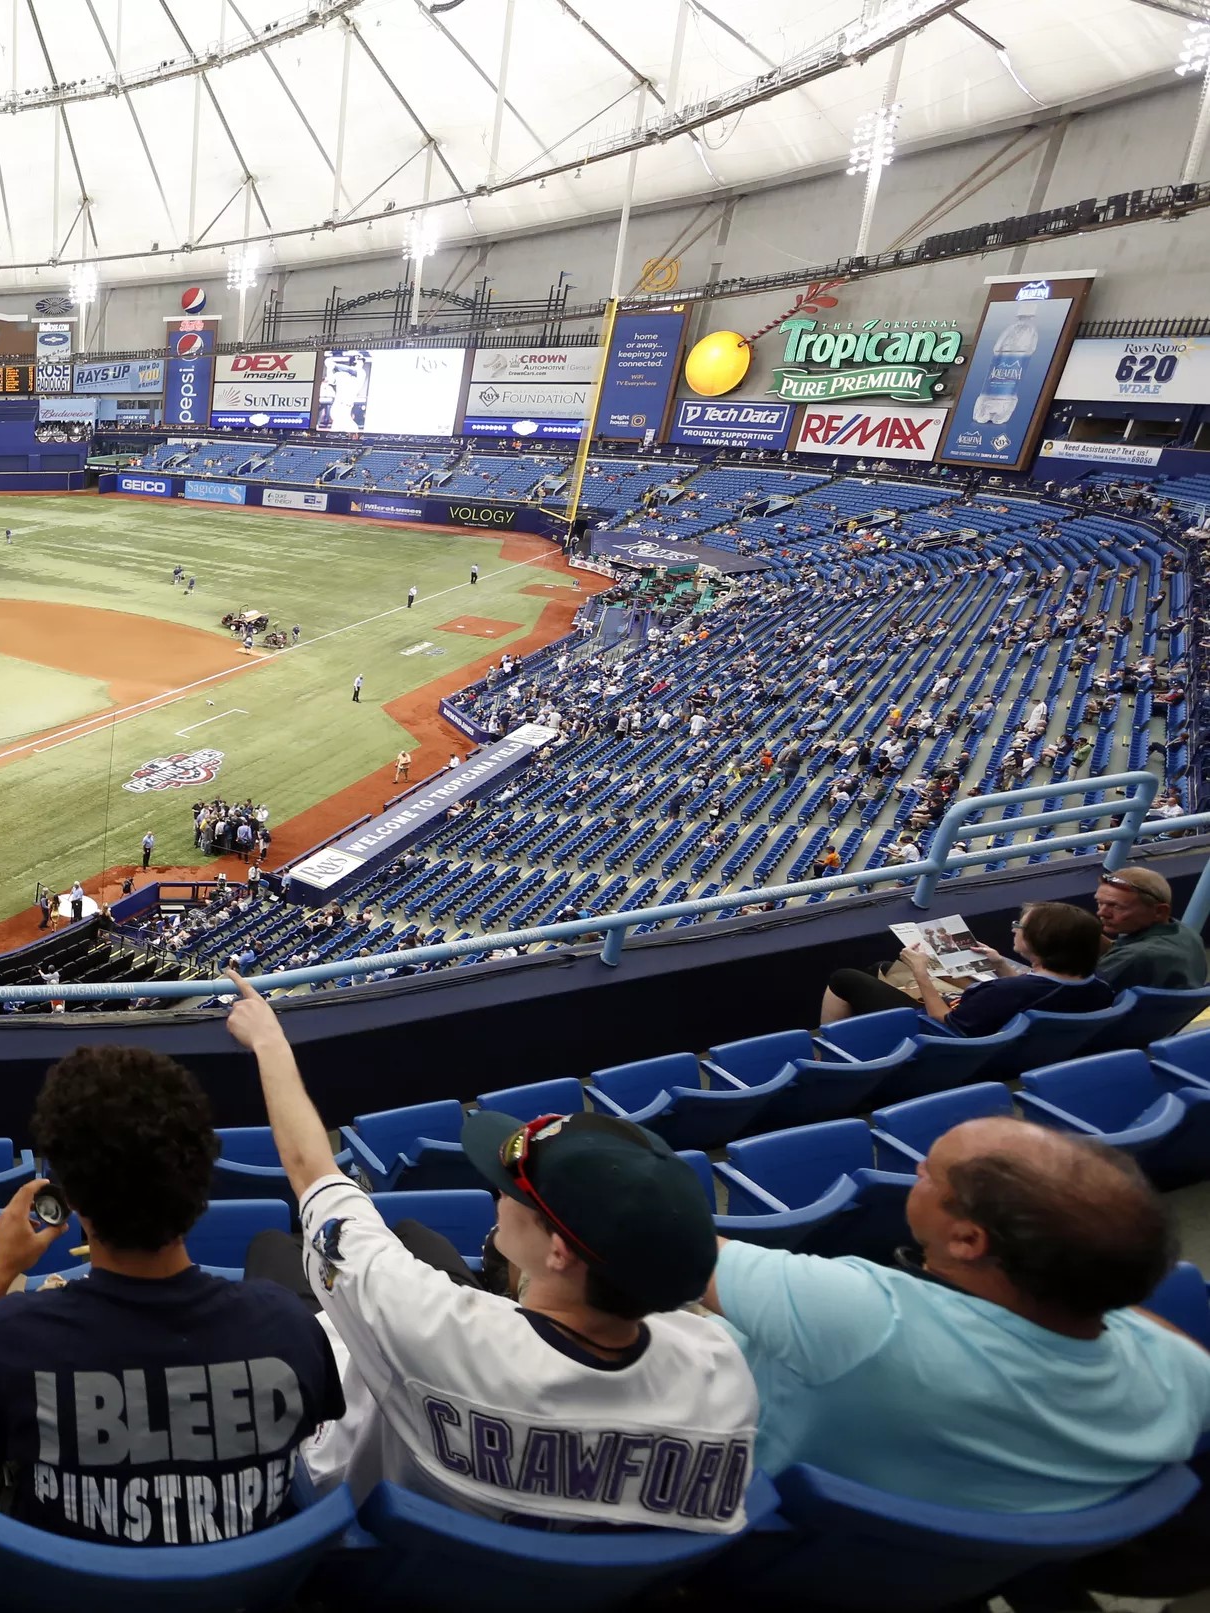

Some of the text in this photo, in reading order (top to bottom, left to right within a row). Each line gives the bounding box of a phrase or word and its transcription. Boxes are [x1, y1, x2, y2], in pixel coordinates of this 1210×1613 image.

[1016, 286, 1050, 300] AQUAFINA
[822, 320, 958, 330] THE ORIGINAL
[634, 332, 658, 340] home
[778, 319, 962, 369] Tropicana
[1152, 343, 1186, 355] RADIO
[520, 354, 567, 364] CROWN
[618, 350, 668, 359] keeping you
[230, 355, 293, 372] DEX
[1115, 355, 1180, 384] 620
[37, 365, 70, 378] ROSE
[76, 365, 131, 384] RAYS UP
[138, 370, 160, 382] YOU
[243, 371, 296, 380] imaging
[989, 367, 1023, 380] AQUAFINA
[36, 378, 70, 392] RADIOLOGY
[780, 372, 924, 397] PURE PREMIUM
[1119, 384, 1162, 394] WDAE
[502, 392, 586, 404] FOUNDATION
[40, 408, 94, 418] Budweiser
[704, 406, 780, 424] Tech Data
[682, 429, 774, 441] PROUDLY SUPPORTING
[800, 413, 934, 450] RE/MAX
[702, 438, 749, 447] TAMPA BAY
[1064, 444, 1080, 452] Need
[1081, 444, 1120, 454] Assistance?
[1122, 448, 1136, 456] Text
[1131, 456, 1153, 464] 69050
[122, 479, 166, 493] GEICO
[187, 480, 226, 496] Sagicor
[364, 503, 422, 515] MicroLumen
[450, 506, 515, 523] VOLOGY
[123, 749, 224, 792] OPENING SERIES
[346, 742, 525, 853] WELCOME TO TROPICANA FIELD
[299, 854, 348, 880] RAYS
[460, 939, 488, 952] STAND
[490, 934, 525, 949] AGAINST
[19, 987, 34, 998] OR
[35, 986, 68, 998] STAND
[69, 984, 114, 997] AGAINST
[116, 984, 138, 995] RAIL
[34, 1356, 304, 1467] I BLEED
[422, 1396, 750, 1522] CRAWFORD
[34, 1450, 298, 1544] PINSTRIPE
